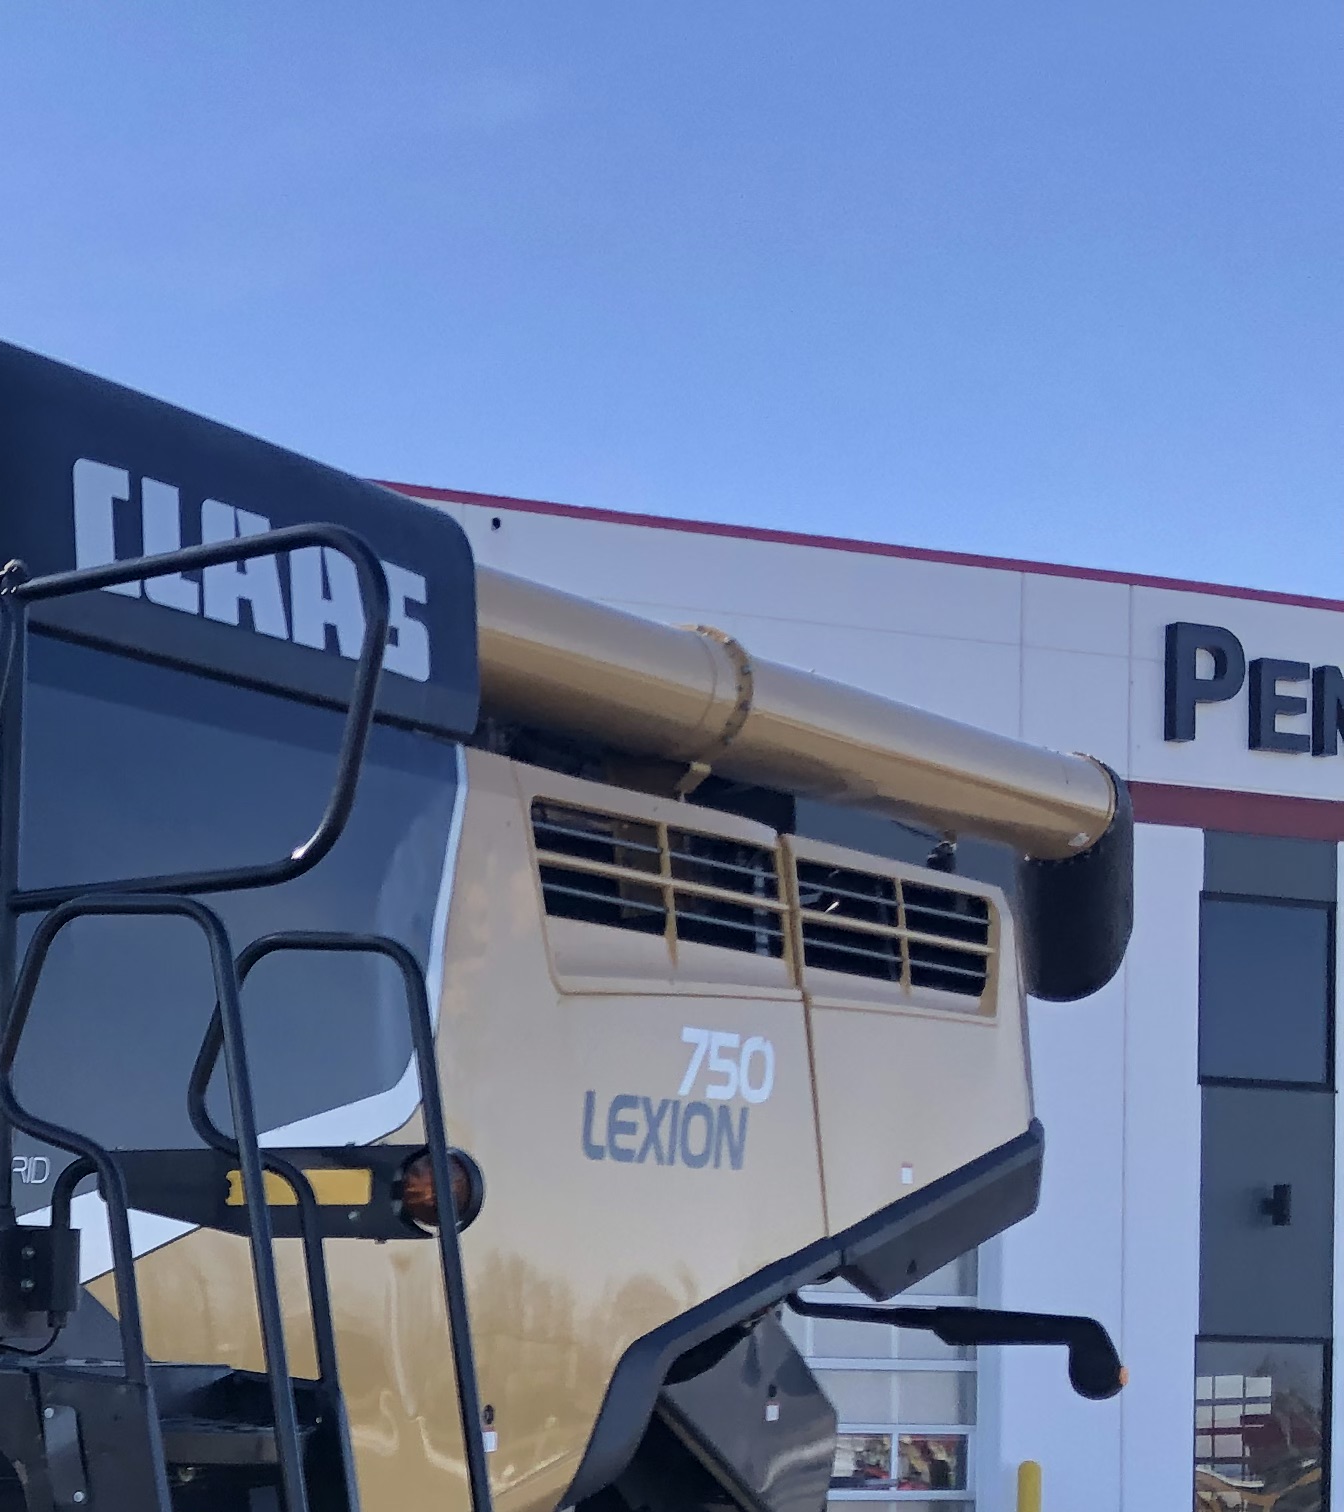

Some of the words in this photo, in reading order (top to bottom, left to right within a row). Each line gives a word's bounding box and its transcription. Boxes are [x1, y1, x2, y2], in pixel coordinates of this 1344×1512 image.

[72, 457, 430, 682] CLAAS
[677, 1026, 775, 1103] 750
[582, 1090, 749, 1170] LEXION
